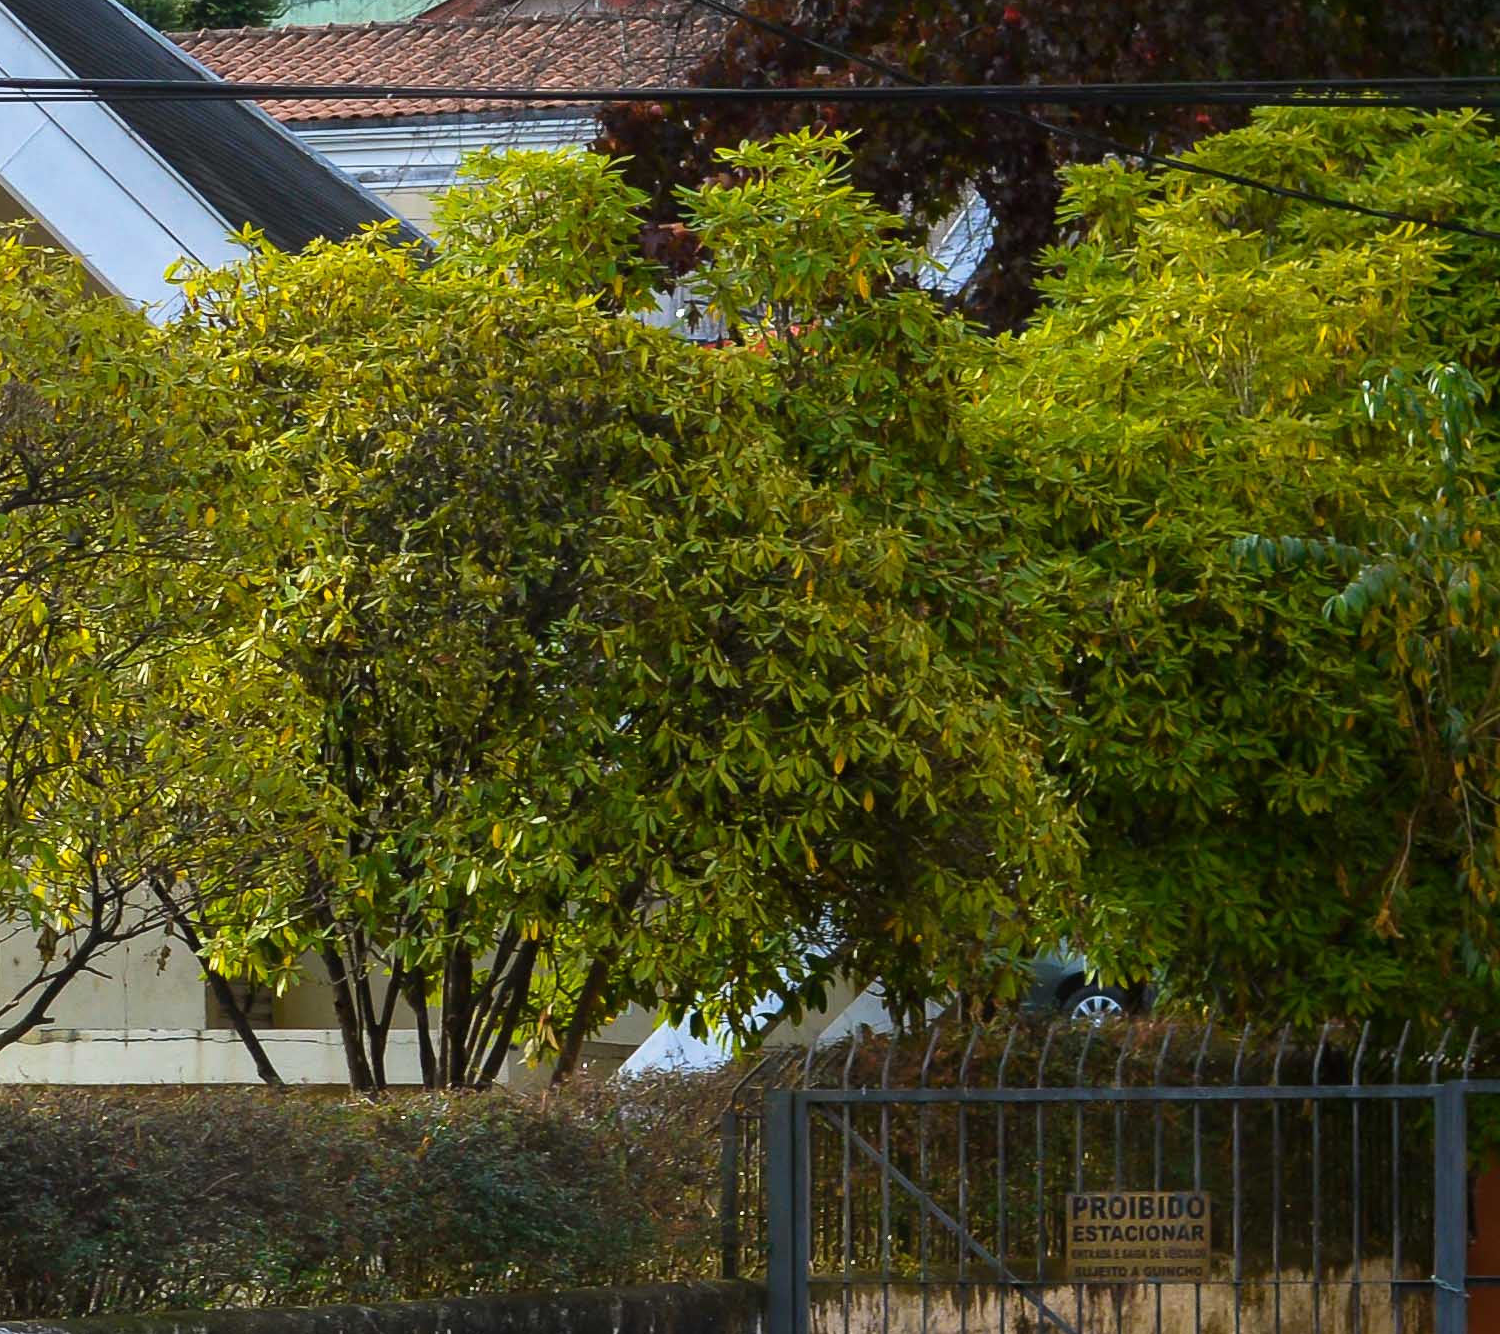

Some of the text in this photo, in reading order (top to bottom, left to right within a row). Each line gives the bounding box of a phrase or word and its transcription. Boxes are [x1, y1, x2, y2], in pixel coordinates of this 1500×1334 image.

[1072, 1195, 1206, 1220] PROIBIDO
[1072, 1224, 1205, 1242] ESTACIONAR
[1130, 1266, 1140, 1277] A
[1143, 1266, 1203, 1277] GUINCHO
